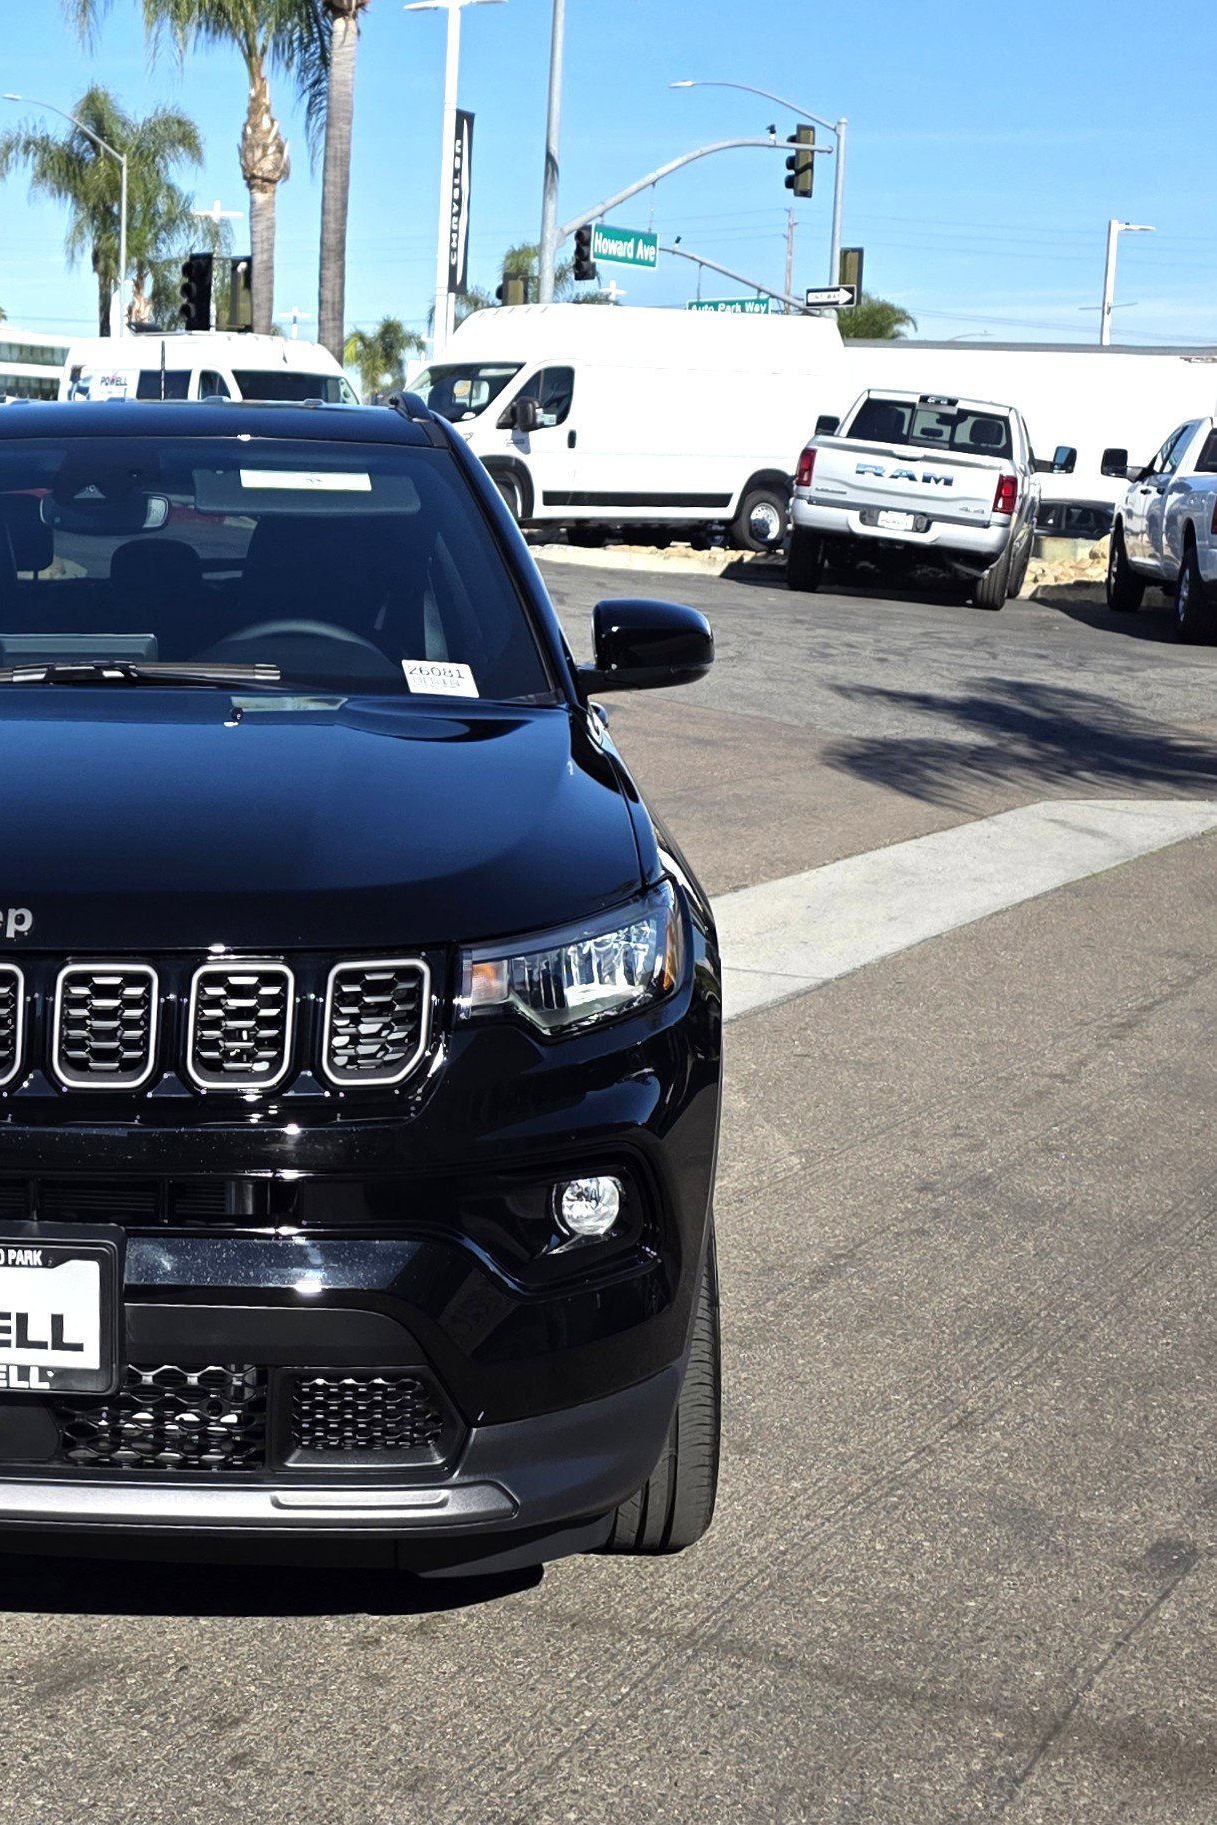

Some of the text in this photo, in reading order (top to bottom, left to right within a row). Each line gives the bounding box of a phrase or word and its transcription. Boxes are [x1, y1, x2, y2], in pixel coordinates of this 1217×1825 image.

[594, 231, 656, 262] Howard Ave
[691, 301, 768, 314] Auto Park Way
[855, 463, 954, 487] RAM
[8, 1249, 43, 1267] PARK
